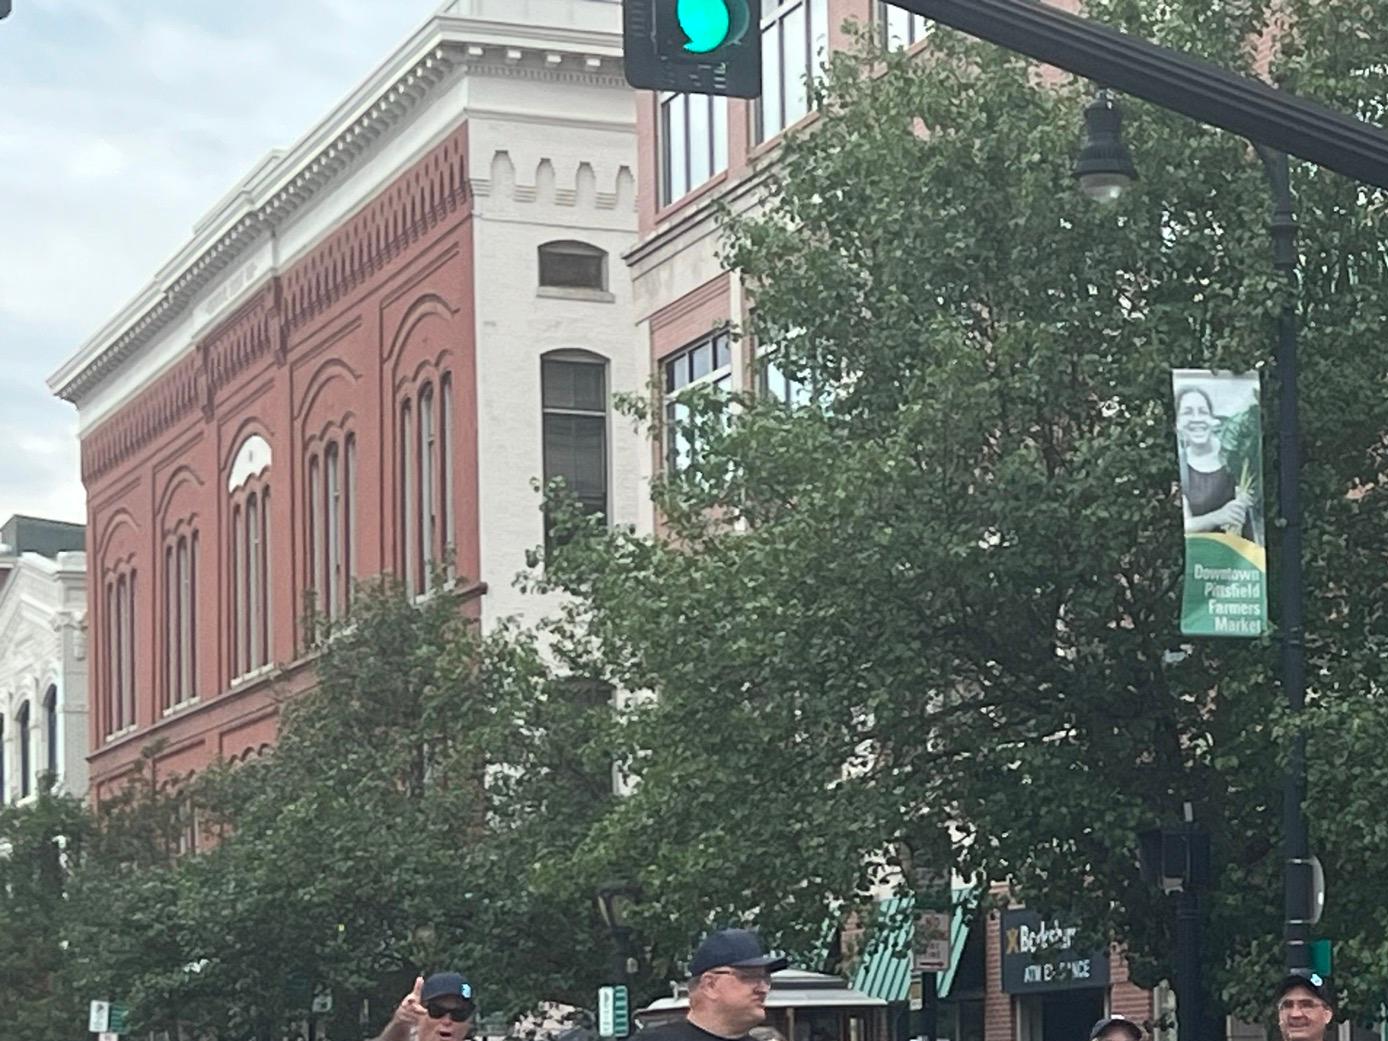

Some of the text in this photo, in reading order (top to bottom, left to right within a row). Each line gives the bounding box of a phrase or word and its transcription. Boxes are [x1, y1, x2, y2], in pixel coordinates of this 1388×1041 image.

[1194, 563, 1260, 580] Downtown
[1204, 581, 1260, 598] Pittsfield
[1208, 598, 1261, 615] Farmers
[1214, 616, 1261, 633] Market
